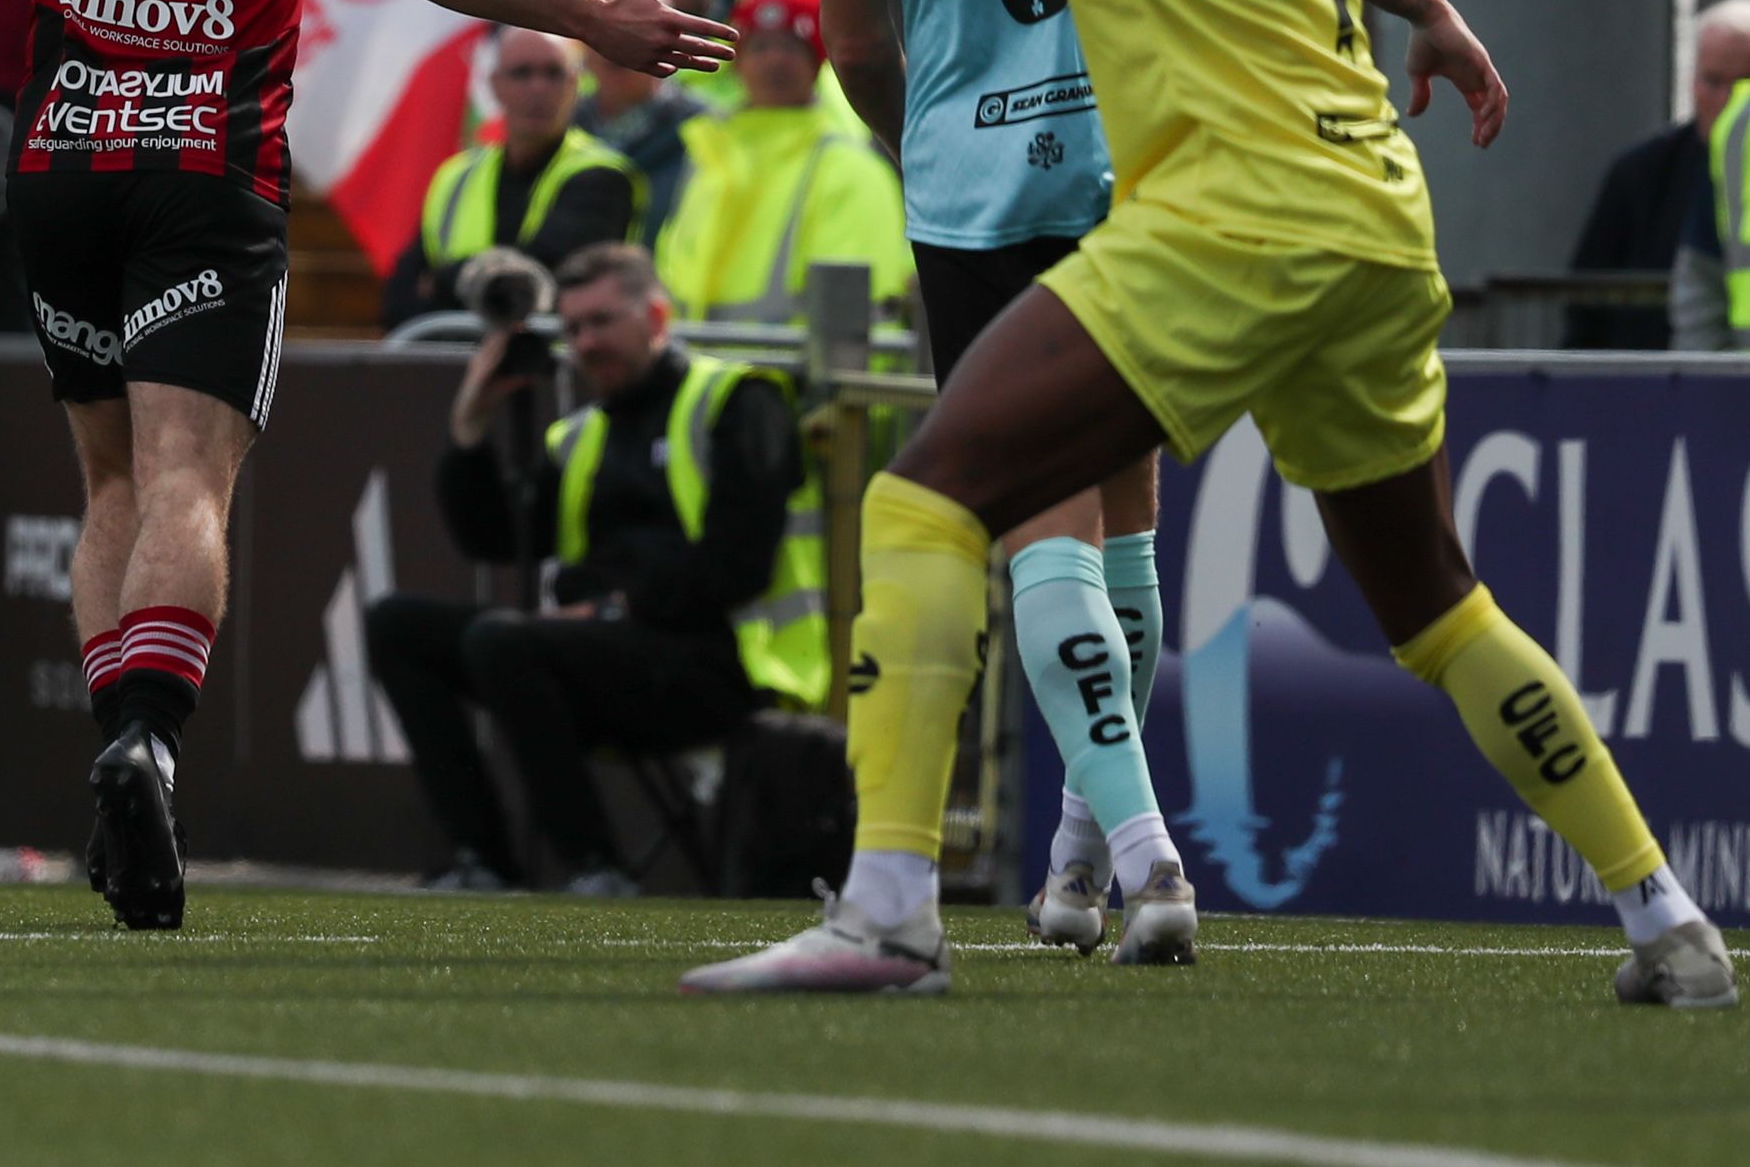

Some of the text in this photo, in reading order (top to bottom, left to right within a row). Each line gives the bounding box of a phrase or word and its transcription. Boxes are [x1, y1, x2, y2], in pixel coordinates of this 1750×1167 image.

[89, 25, 161, 50] WORKSPACE
[162, 38, 232, 56] SOLUTIONS
[28, 134, 217, 152] safeguarding your enjoyment
[122, 269, 224, 350] innov8
